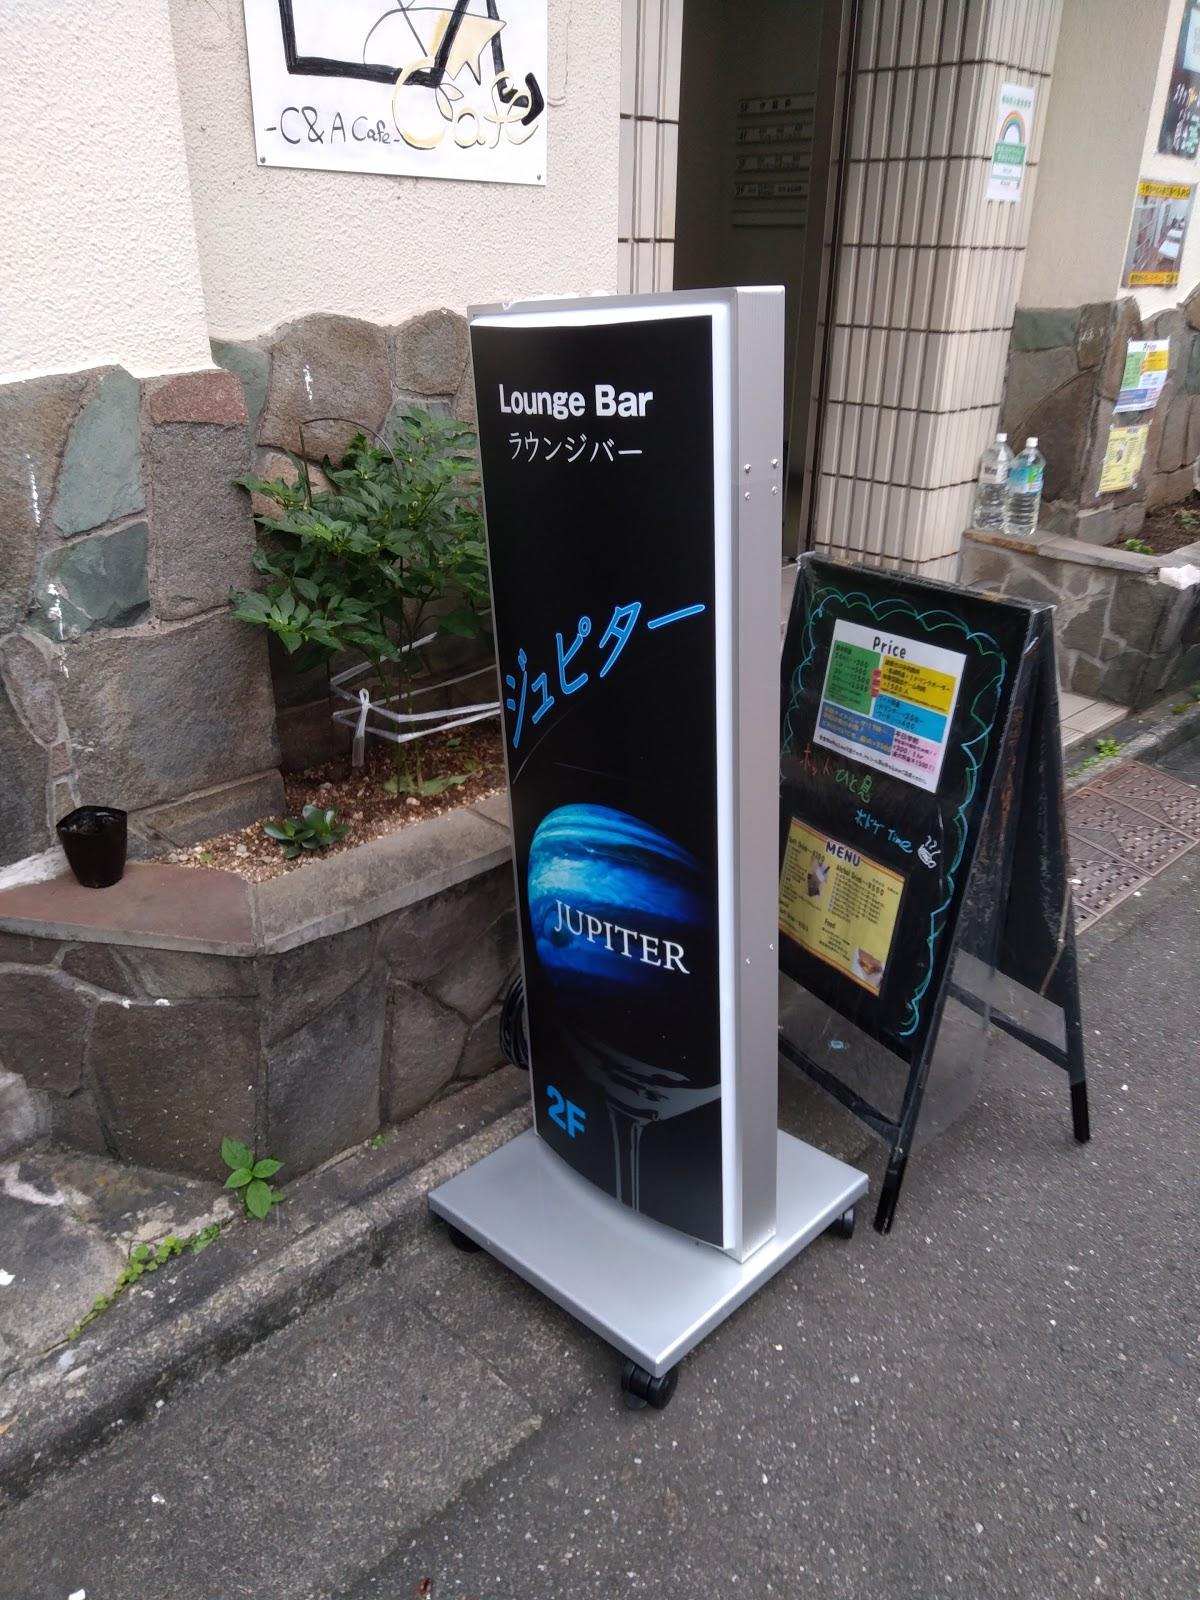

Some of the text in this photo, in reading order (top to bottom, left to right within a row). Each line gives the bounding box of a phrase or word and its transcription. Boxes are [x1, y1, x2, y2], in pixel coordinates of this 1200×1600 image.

[498, 383, 654, 420] Lounge Bar
[508, 431, 643, 463] ラウンジバー
[872, 636, 907, 659] Price
[505, 600, 706, 749] ジュピター
[825, 841, 861, 867] MENU
[554, 899, 690, 975] JUPITER
[545, 1084, 587, 1140] 2F
